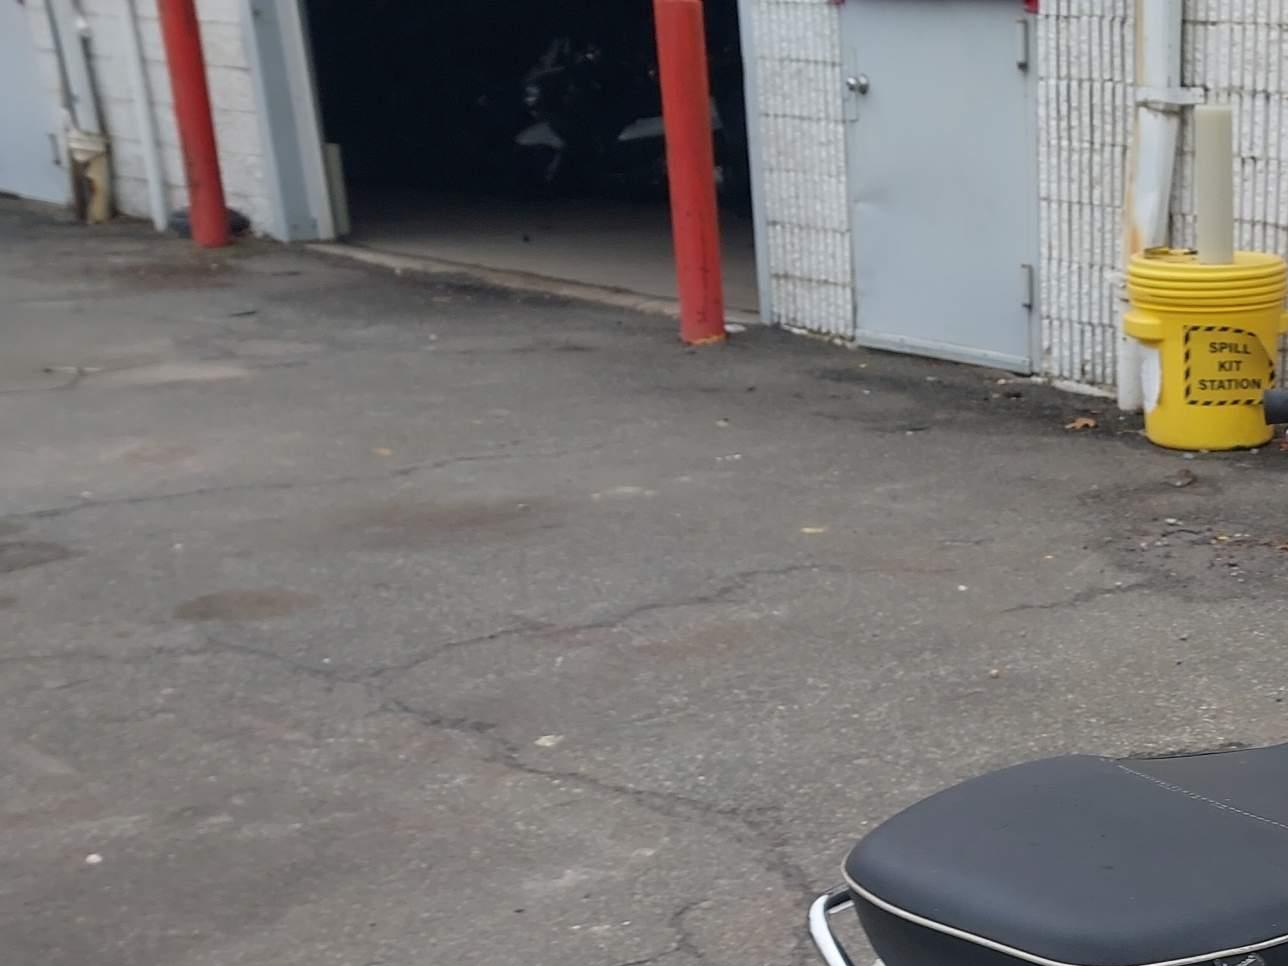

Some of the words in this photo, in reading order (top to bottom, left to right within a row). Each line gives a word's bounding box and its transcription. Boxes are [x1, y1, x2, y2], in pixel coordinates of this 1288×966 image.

[1209, 342, 1251, 355] SPILL
[1217, 360, 1242, 372] KIT
[1199, 378, 1262, 391] STATION
